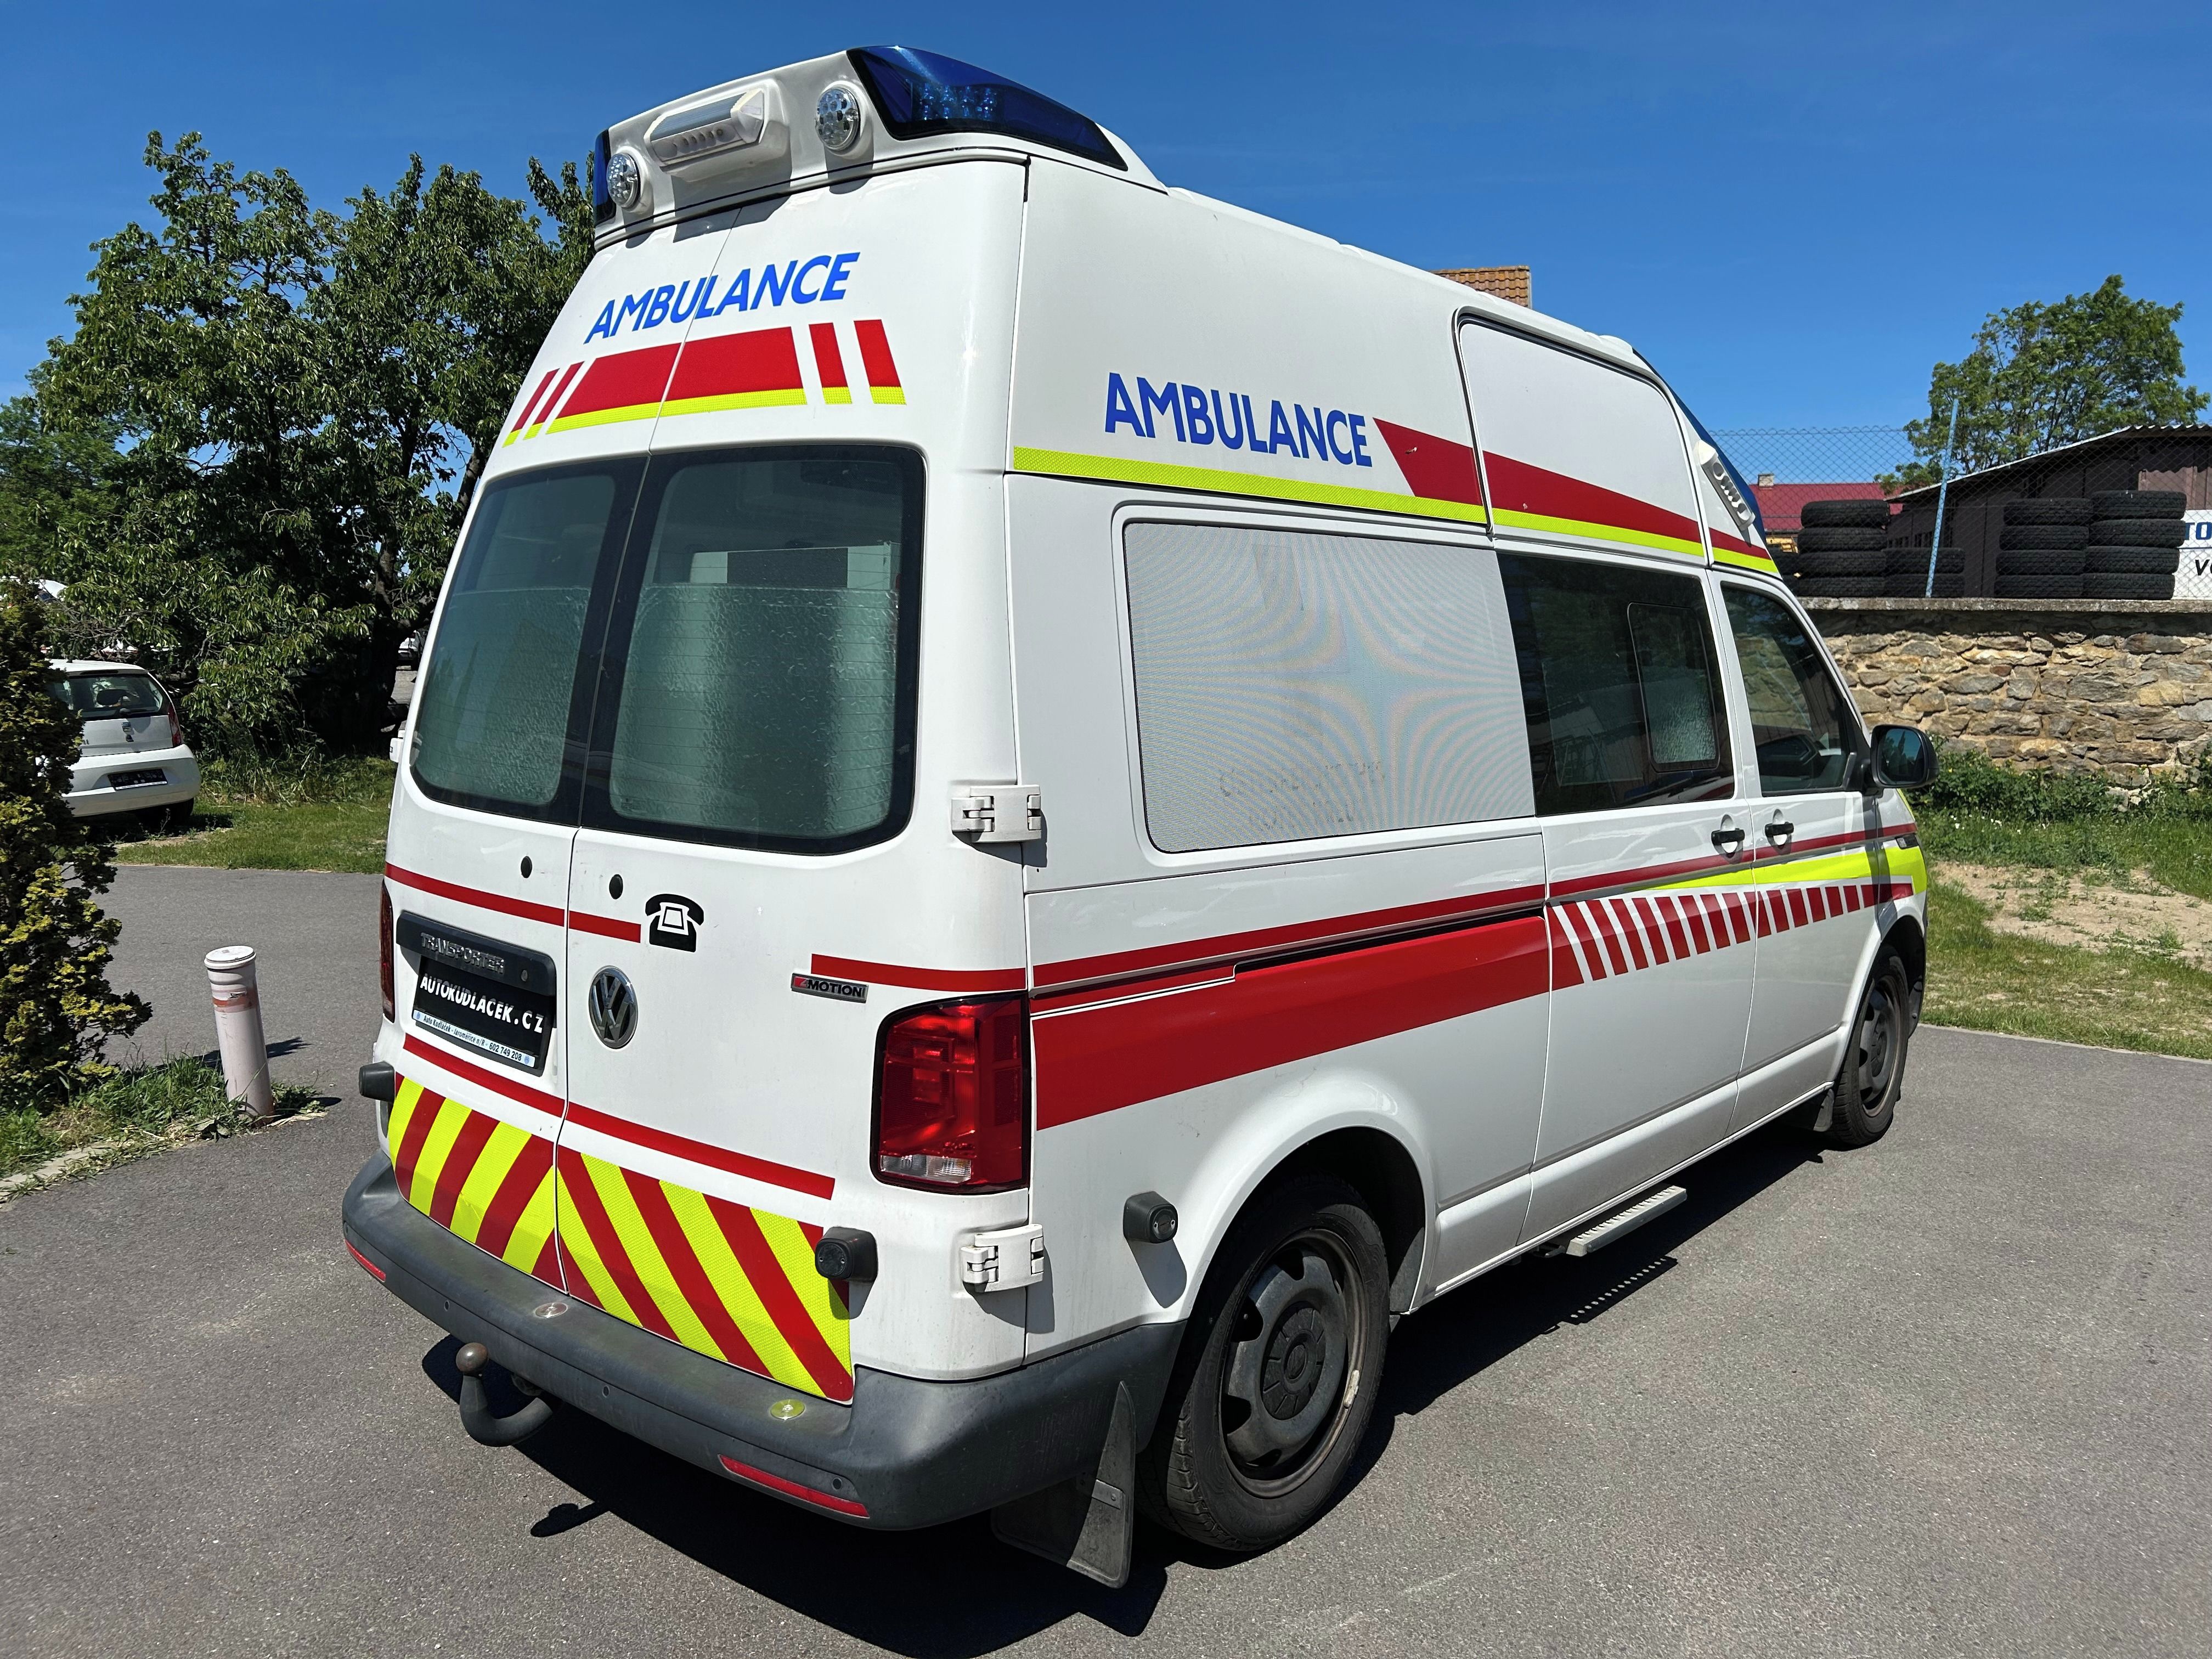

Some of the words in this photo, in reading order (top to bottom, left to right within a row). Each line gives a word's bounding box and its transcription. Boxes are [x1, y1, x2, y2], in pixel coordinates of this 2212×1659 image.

[584, 252, 860, 344] AMBULANCE
[1105, 372, 1373, 467] AMBULANCE
[420, 932, 505, 974] TRANSPORTER
[420, 973, 544, 1034] AUTOKUDLACEK.CZ
[424, 1015, 433, 1025] Auto
[489, 1042, 500, 1053] 602
[500, 1046, 510, 1057] 749
[511, 1051, 522, 1062] 208
